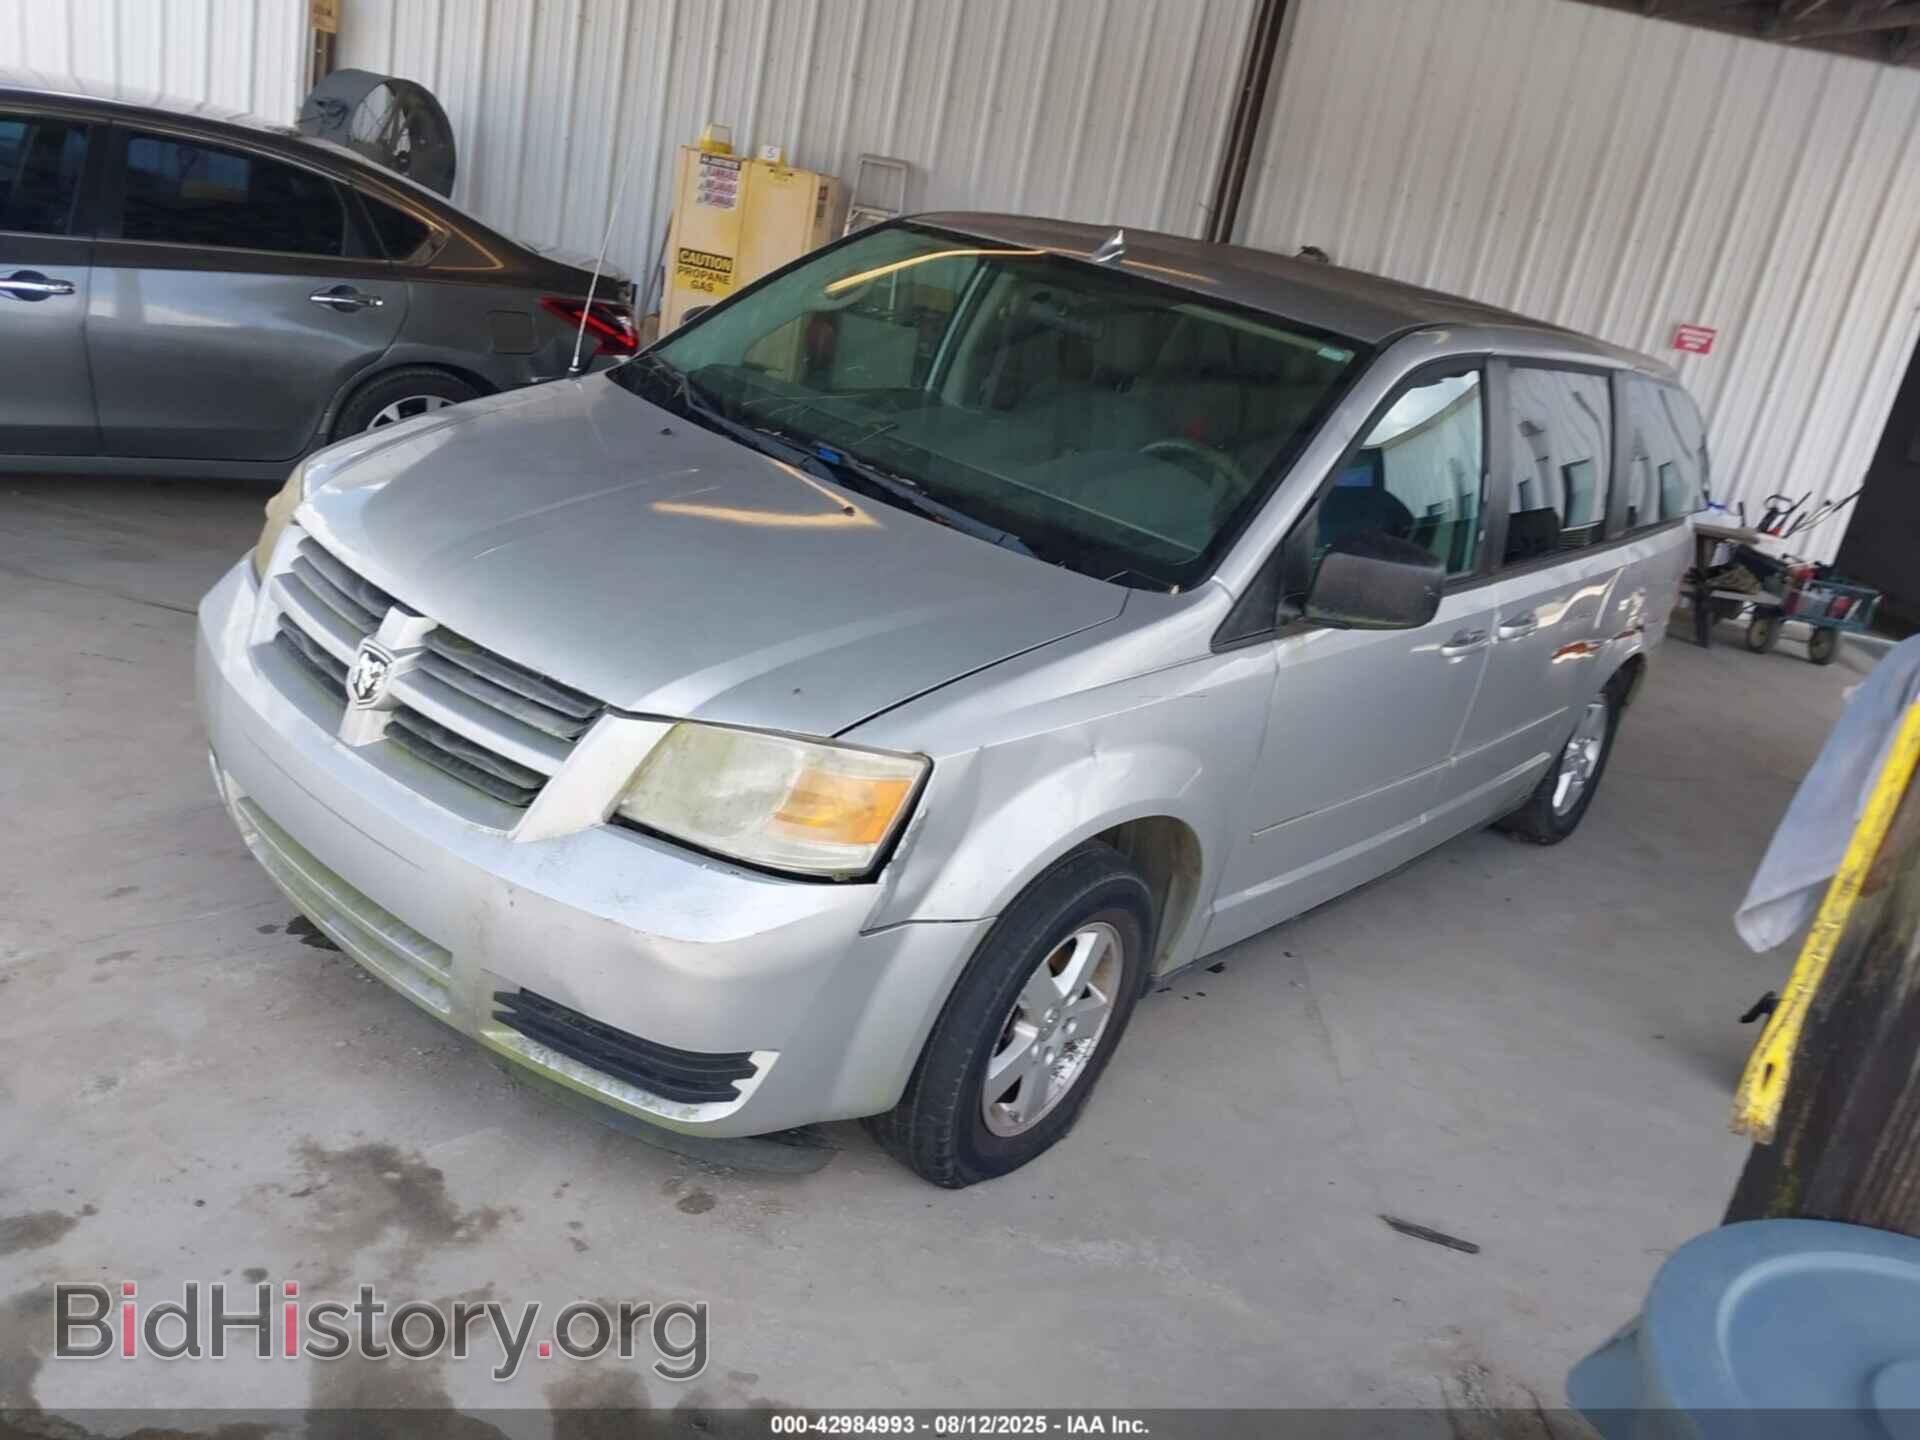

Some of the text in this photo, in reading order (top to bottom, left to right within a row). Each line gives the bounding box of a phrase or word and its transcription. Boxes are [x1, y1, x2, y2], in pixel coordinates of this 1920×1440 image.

[680, 250, 732, 271] CAUTION
[678, 265, 731, 285] PROPANE
[691, 280, 714, 292] GAS
